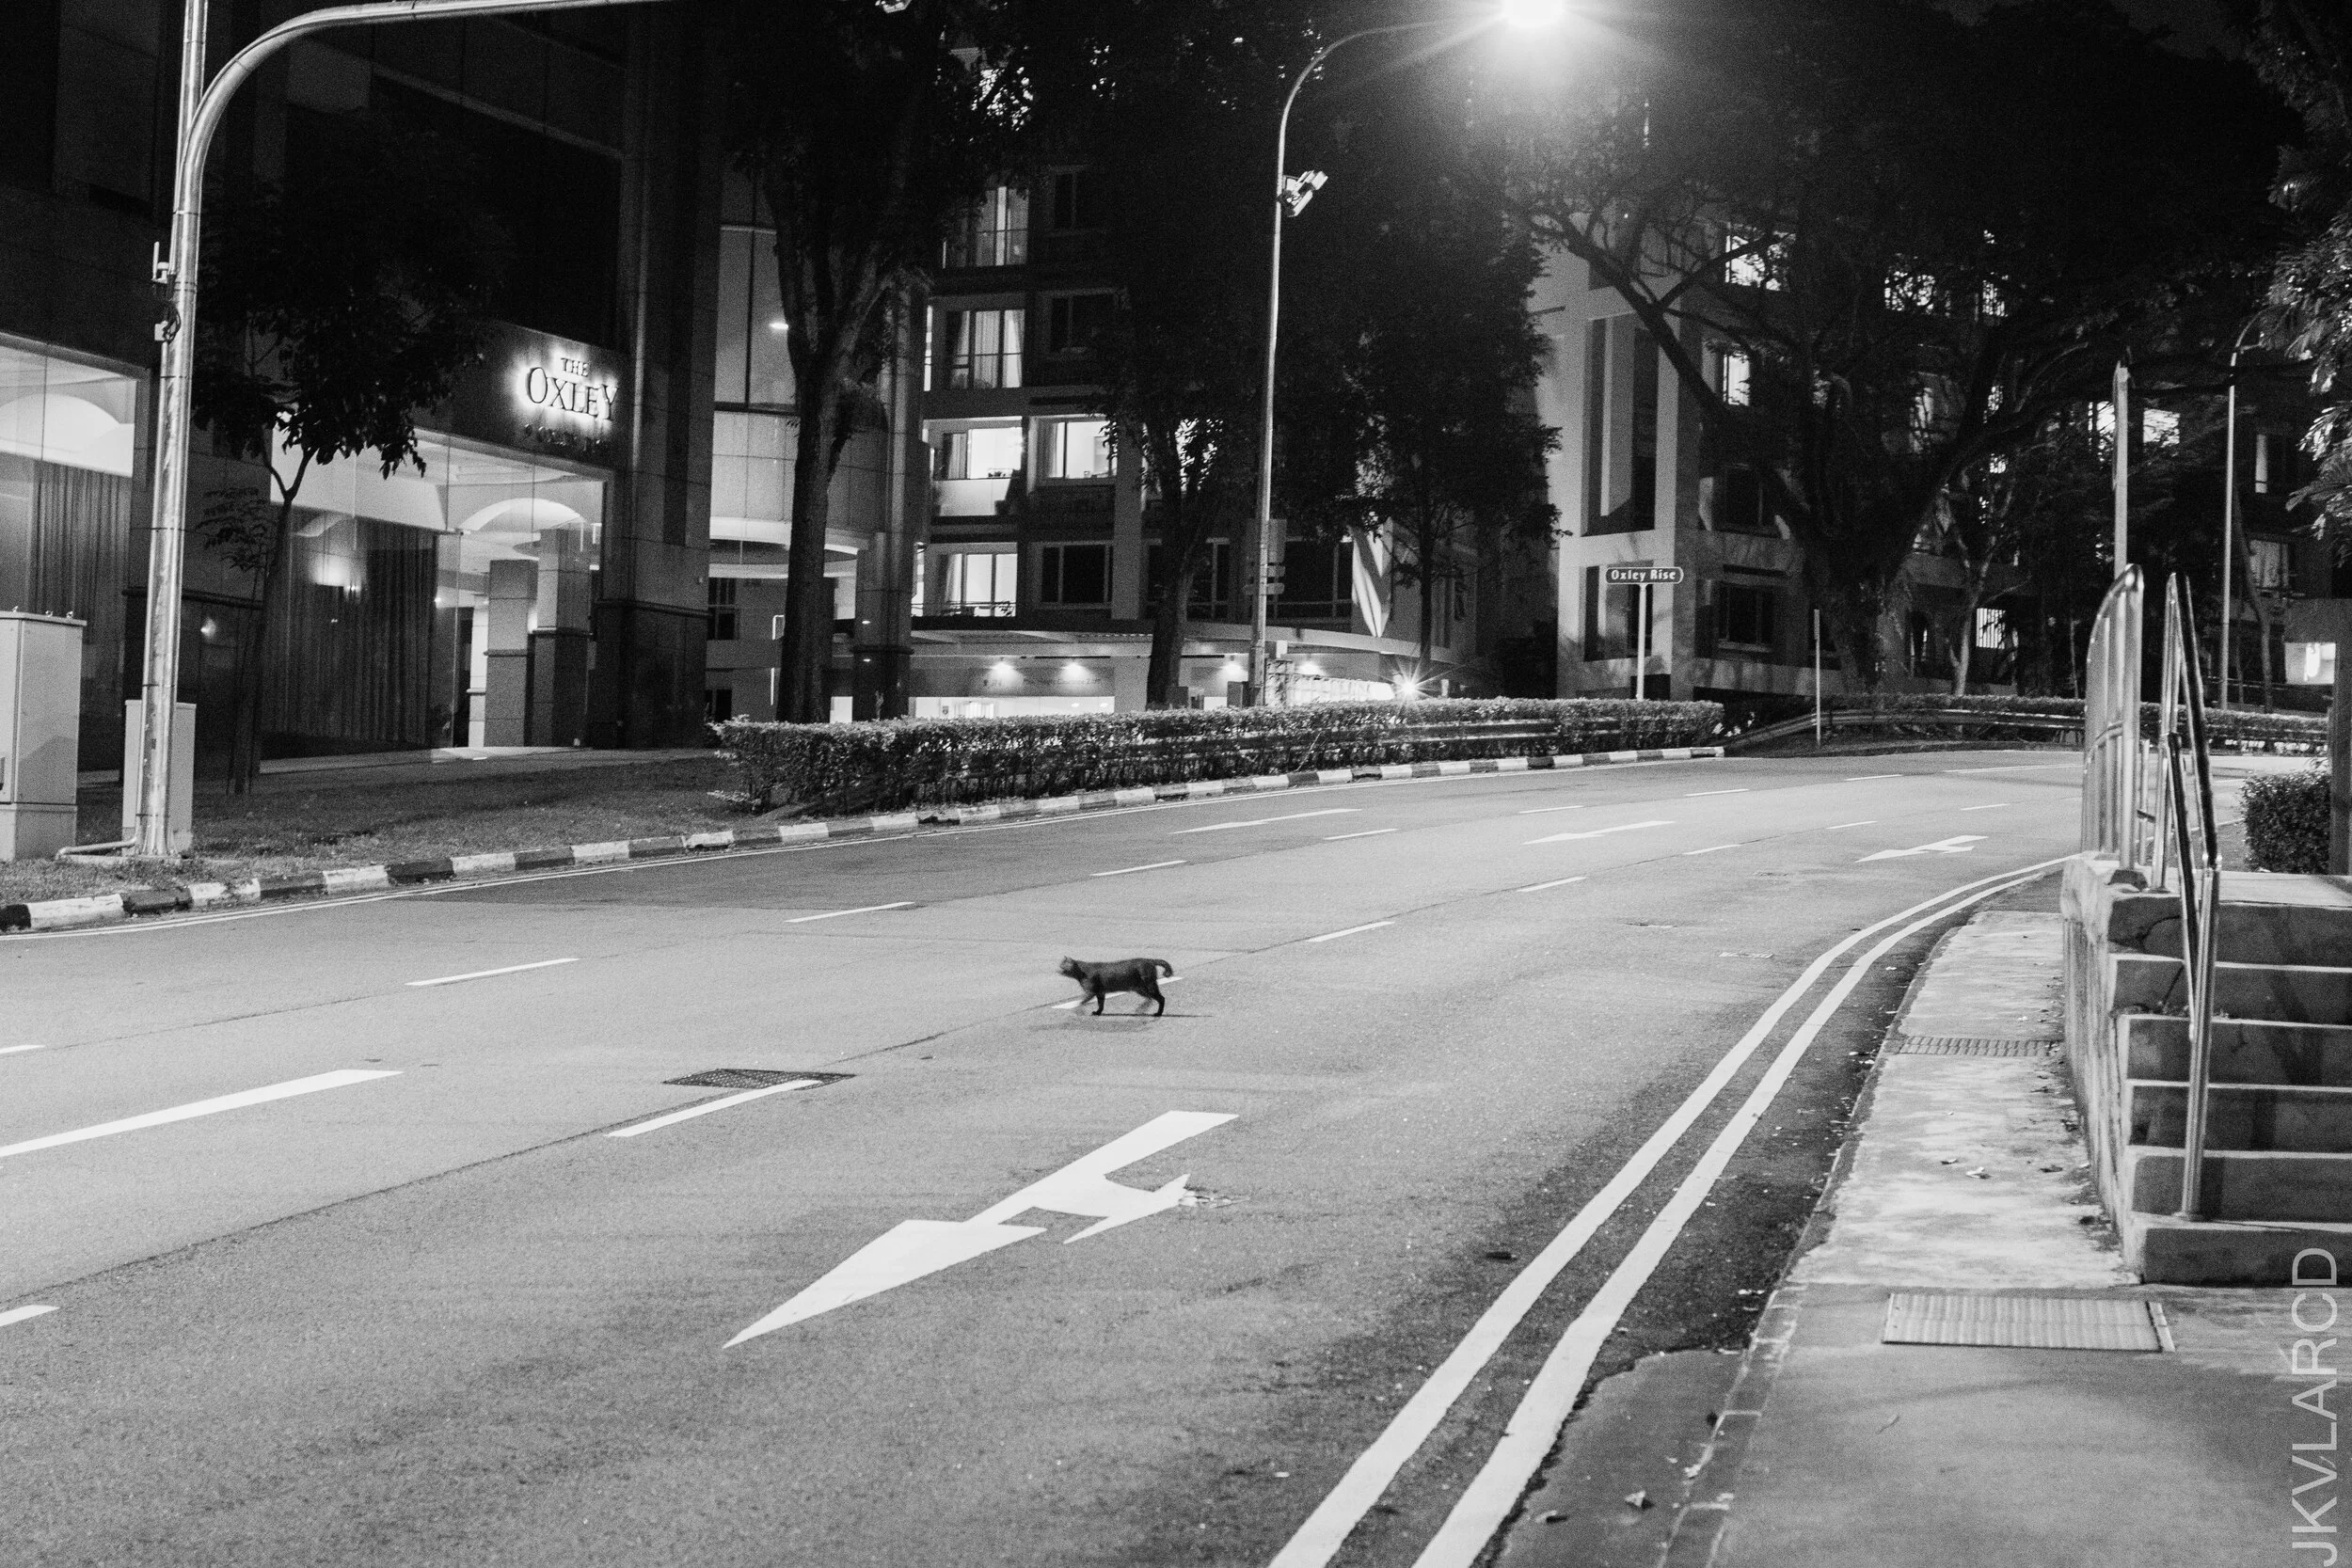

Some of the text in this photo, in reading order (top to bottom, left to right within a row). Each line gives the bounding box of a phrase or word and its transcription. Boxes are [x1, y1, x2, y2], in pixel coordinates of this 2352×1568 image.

[561, 357, 589, 377] THE
[526, 367, 618, 420] OXLEY
[1611, 569, 1676, 582] Oxley Rise
